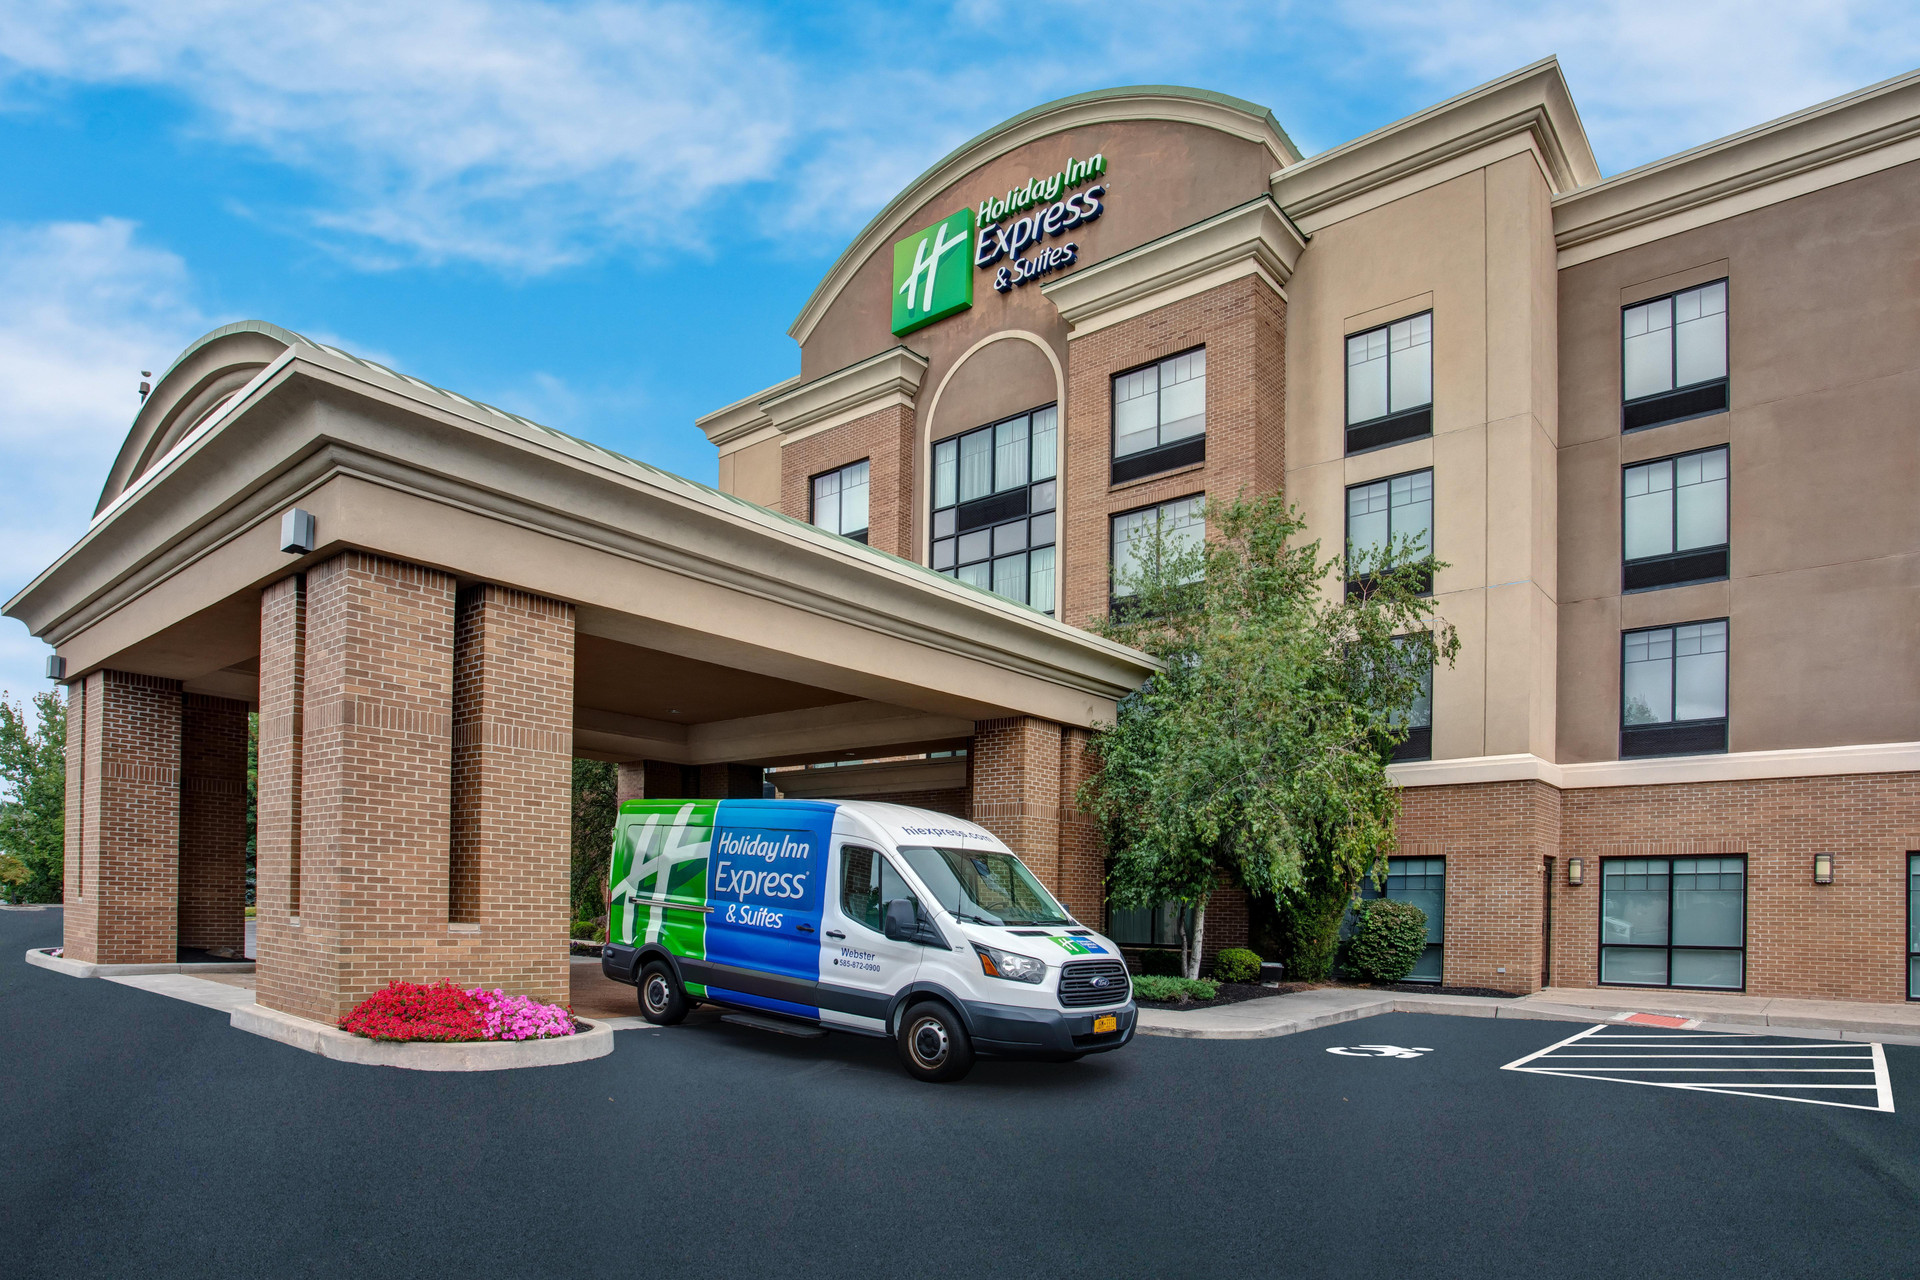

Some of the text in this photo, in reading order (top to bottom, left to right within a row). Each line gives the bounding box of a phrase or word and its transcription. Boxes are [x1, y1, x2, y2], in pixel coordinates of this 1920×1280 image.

[976, 153, 1107, 227] Holiday Inn
[974, 185, 1104, 267] Express
[993, 242, 1077, 291] & Suites
[717, 831, 809, 863] Holiday Inn
[902, 826, 993, 843] hiexpress.com
[715, 861, 807, 902] Express
[725, 904, 783, 929] & Suites
[839, 959, 881, 972] 585-872-0900
[841, 947, 875, 961] Webster
